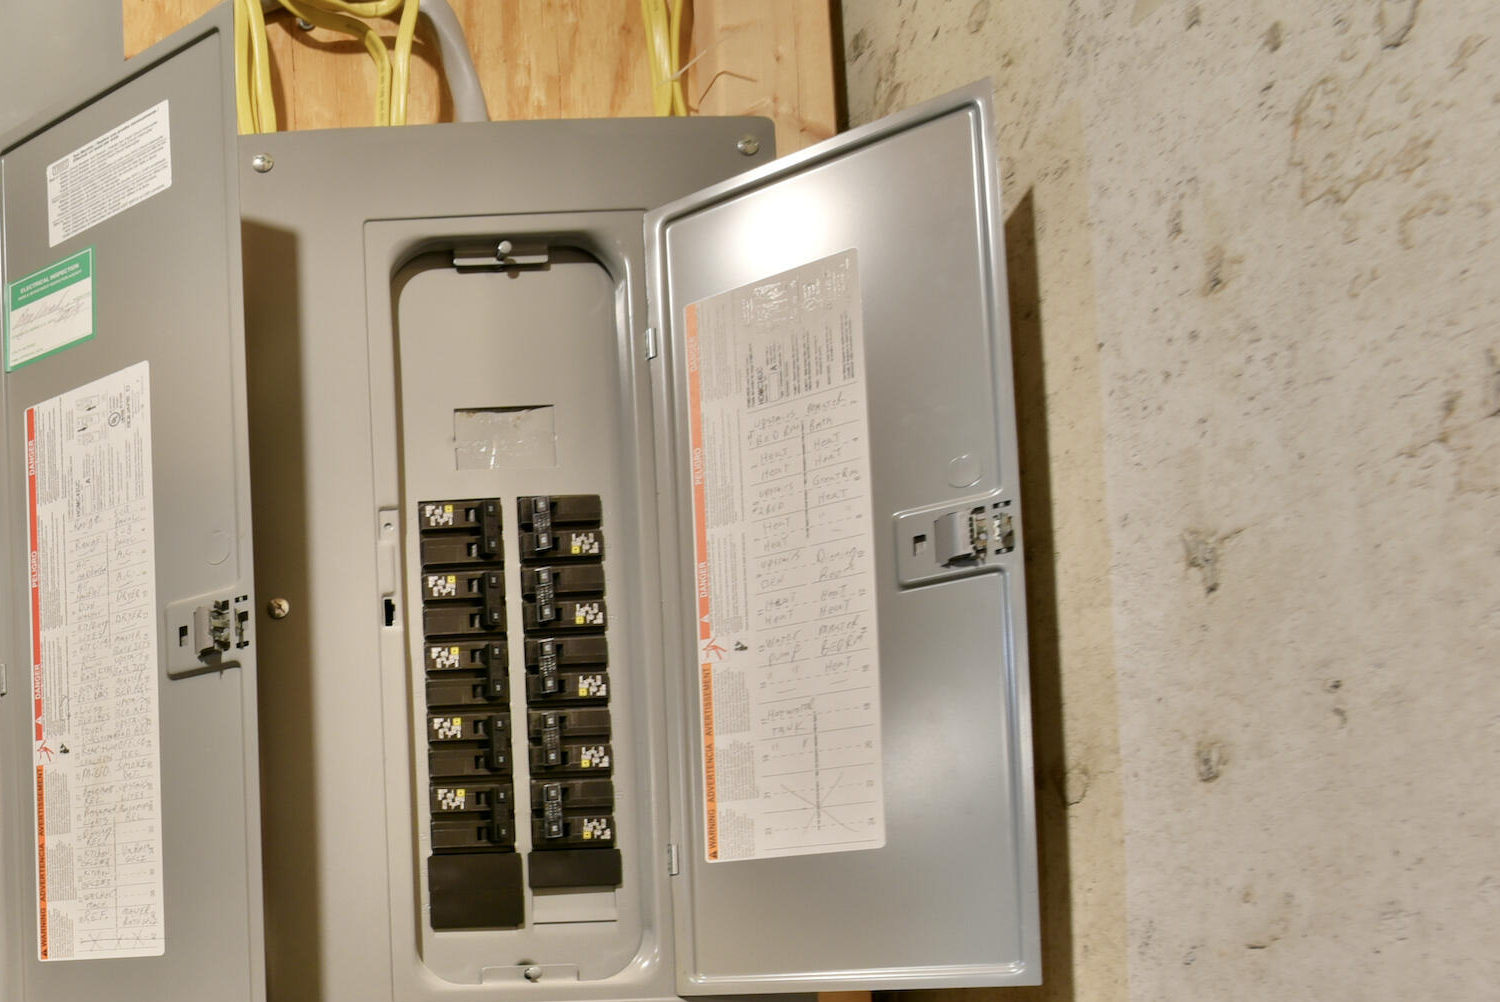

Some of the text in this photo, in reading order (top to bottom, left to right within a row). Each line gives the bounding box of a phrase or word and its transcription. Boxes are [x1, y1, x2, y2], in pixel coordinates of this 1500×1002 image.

[689, 336, 697, 371] DANGER
[28, 440, 36, 476] DANGER
[694, 447, 702, 485] PELIGRO
[700, 562, 708, 598] DANGER
[702, 668, 717, 848] WARNING ADVERTENCIA AVERTISSEMENT
[37, 769, 45, 836] AVERTISSEMENT
